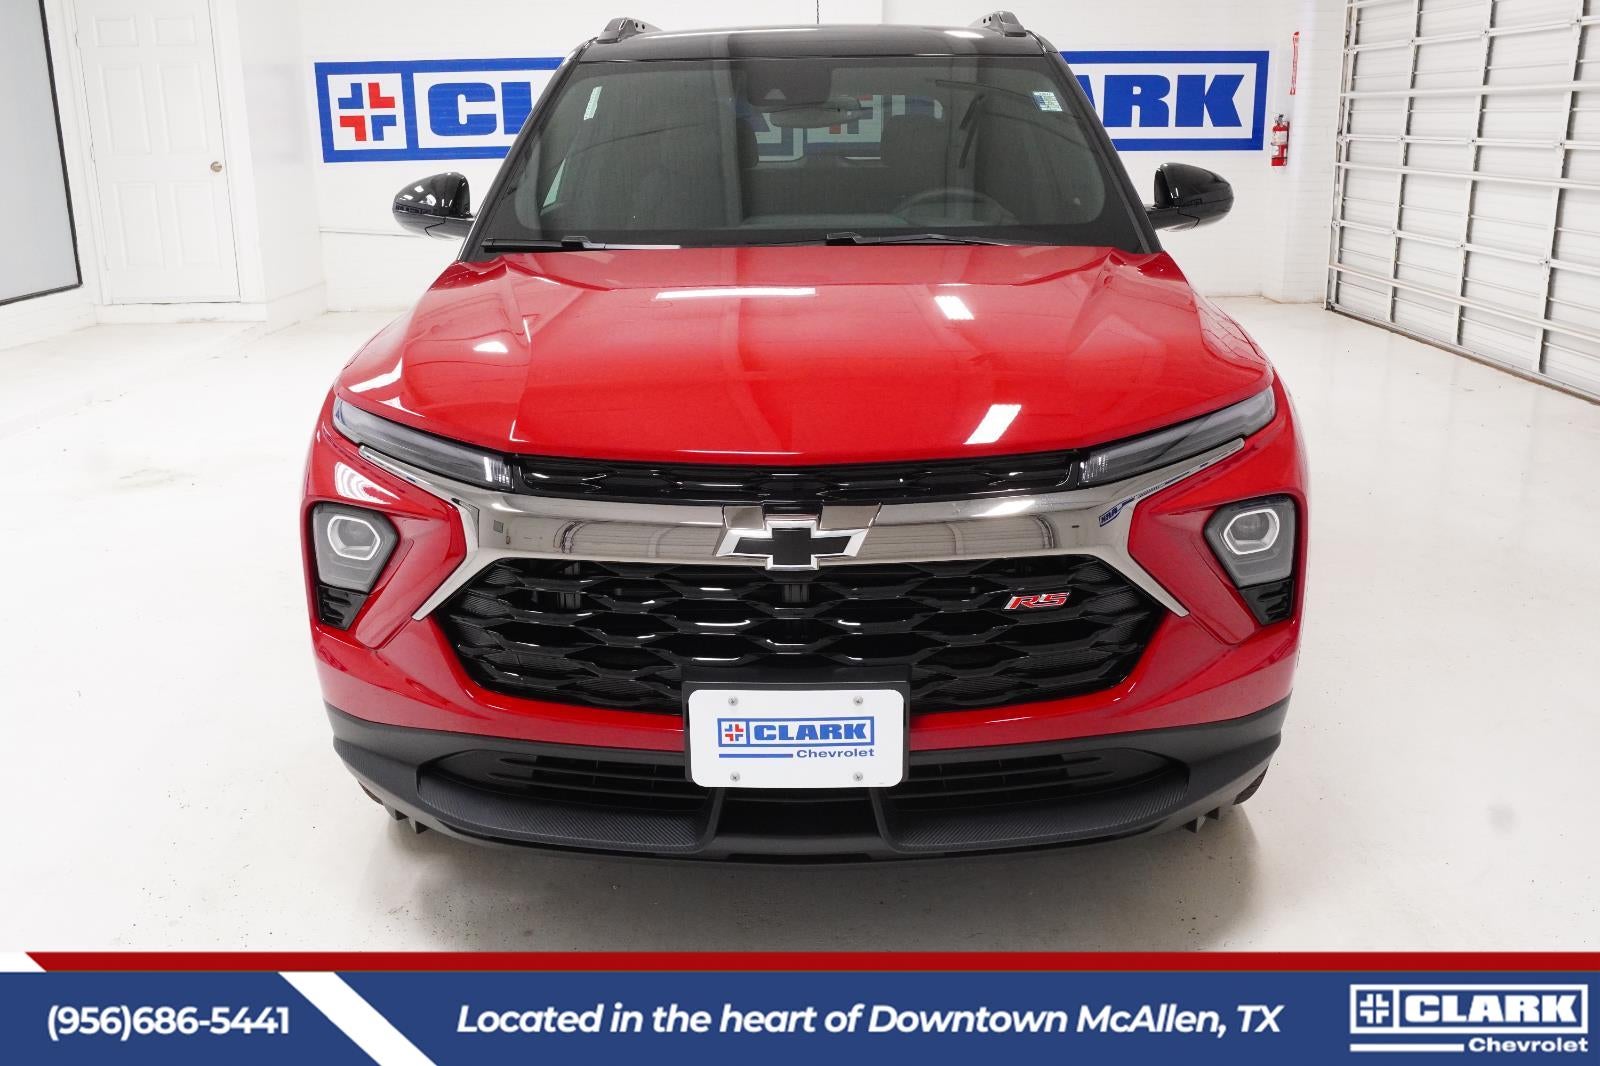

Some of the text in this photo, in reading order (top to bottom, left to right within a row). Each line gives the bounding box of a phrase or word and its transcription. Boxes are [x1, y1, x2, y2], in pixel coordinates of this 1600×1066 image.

[1003, 591, 1070, 610] RS
[753, 723, 867, 741] CLARK
[796, 748, 875, 758] Chevrolet
